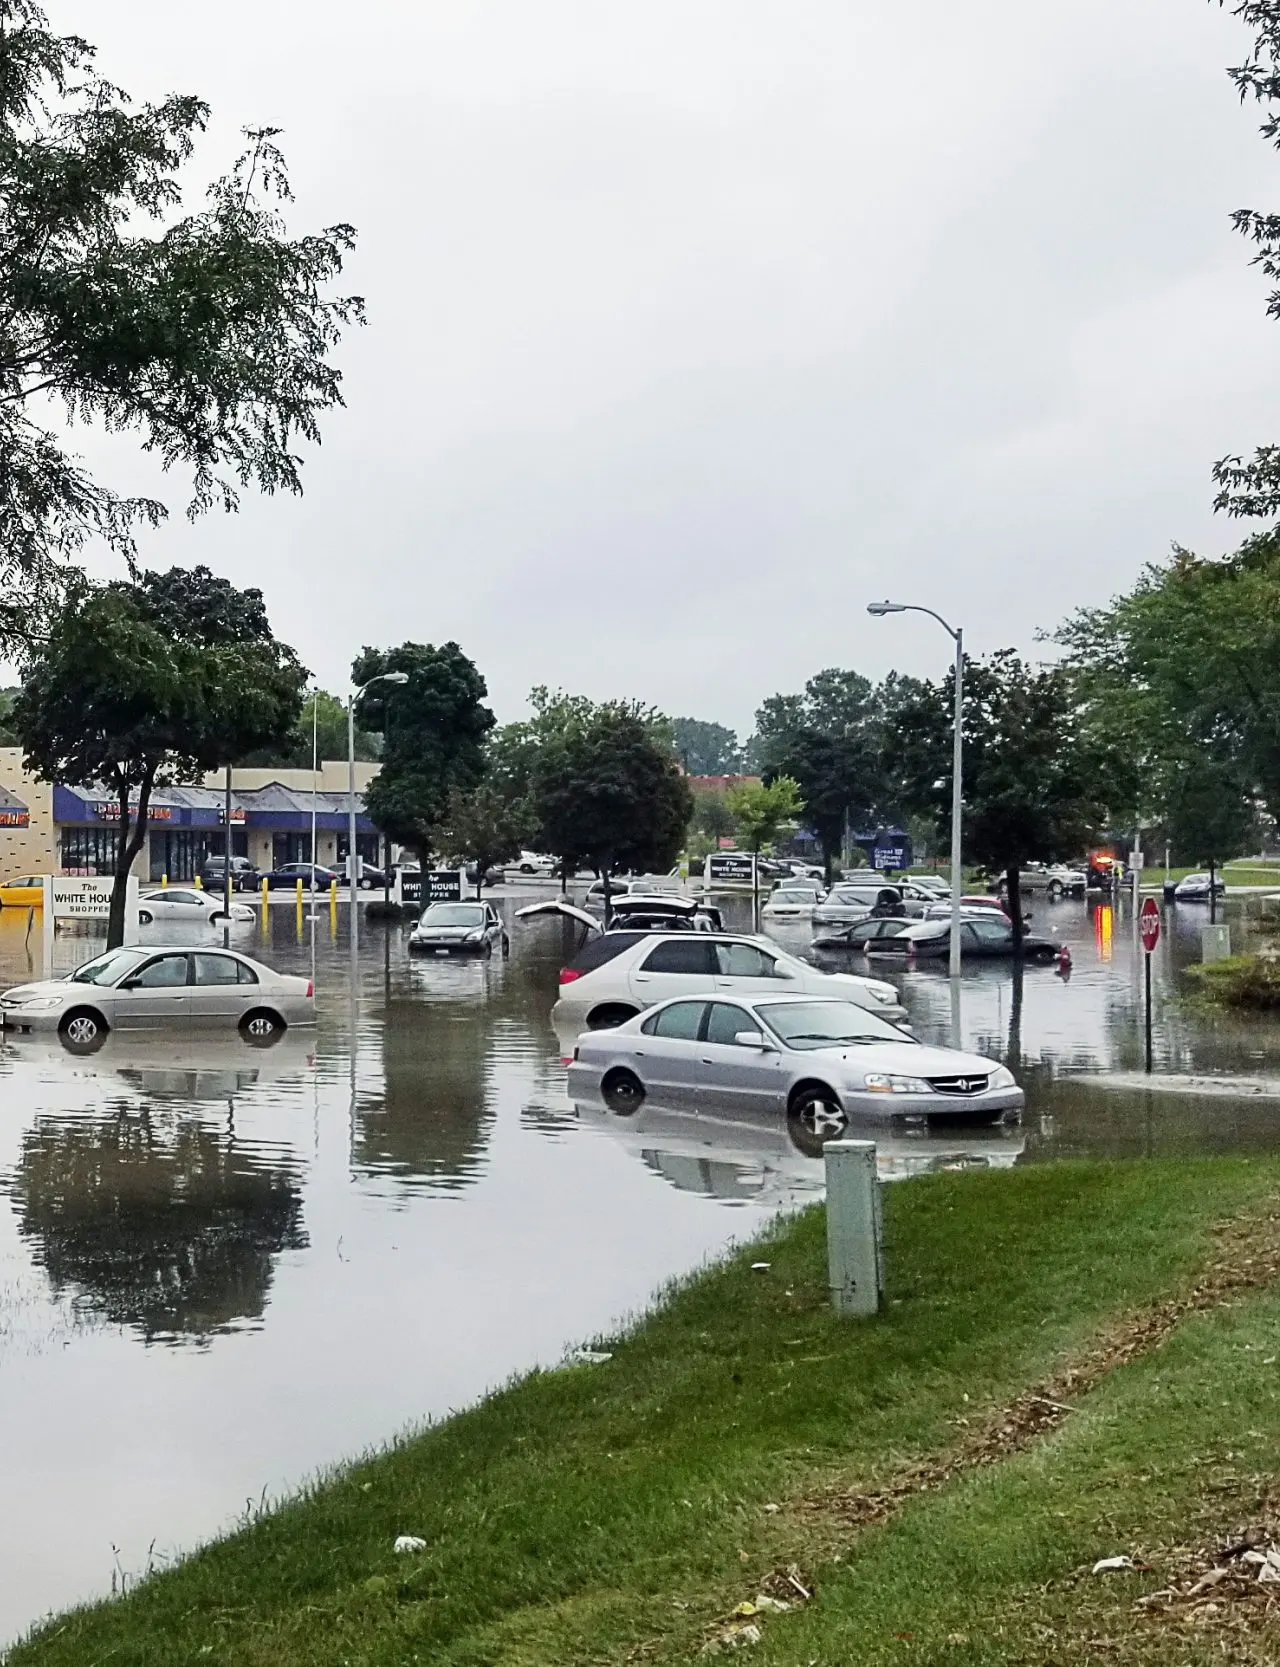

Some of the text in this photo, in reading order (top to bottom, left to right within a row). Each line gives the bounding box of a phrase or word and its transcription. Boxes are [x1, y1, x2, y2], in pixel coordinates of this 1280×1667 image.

[431, 883, 459, 891] HOUSE
[54, 894, 112, 903] WHITE HOU
[1141, 913, 1159, 936] STOP
